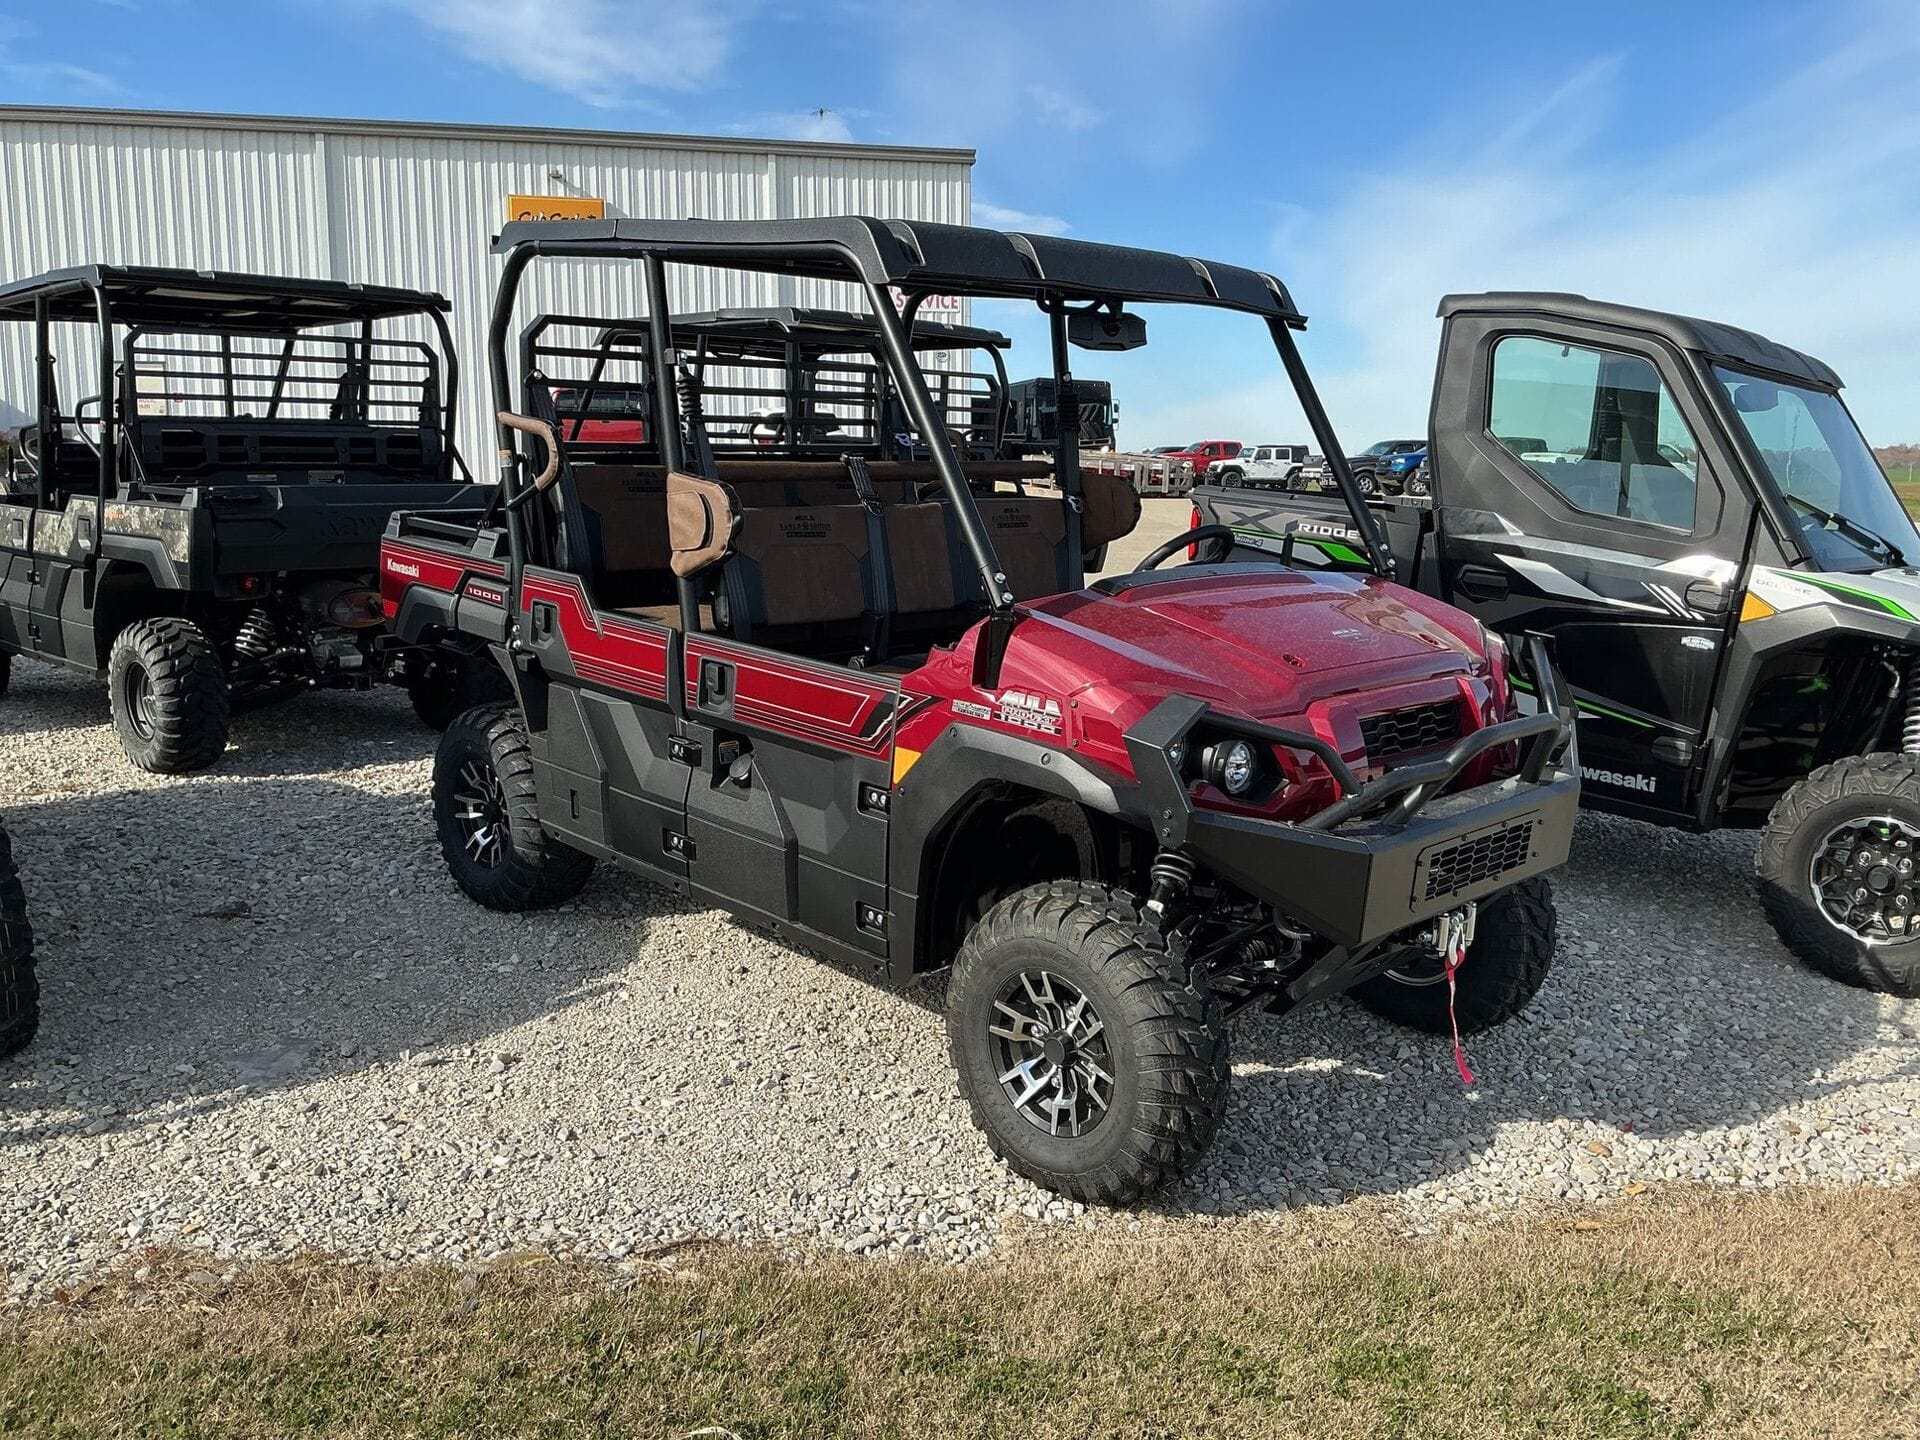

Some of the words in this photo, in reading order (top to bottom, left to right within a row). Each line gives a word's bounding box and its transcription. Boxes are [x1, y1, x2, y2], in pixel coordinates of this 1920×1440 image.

[896, 292, 959, 309] SVICE
[1298, 522, 1361, 539] RIDGE
[387, 557, 419, 578] Kawasaki
[468, 586, 501, 601] 1000
[1580, 765, 1656, 793] wasaki
